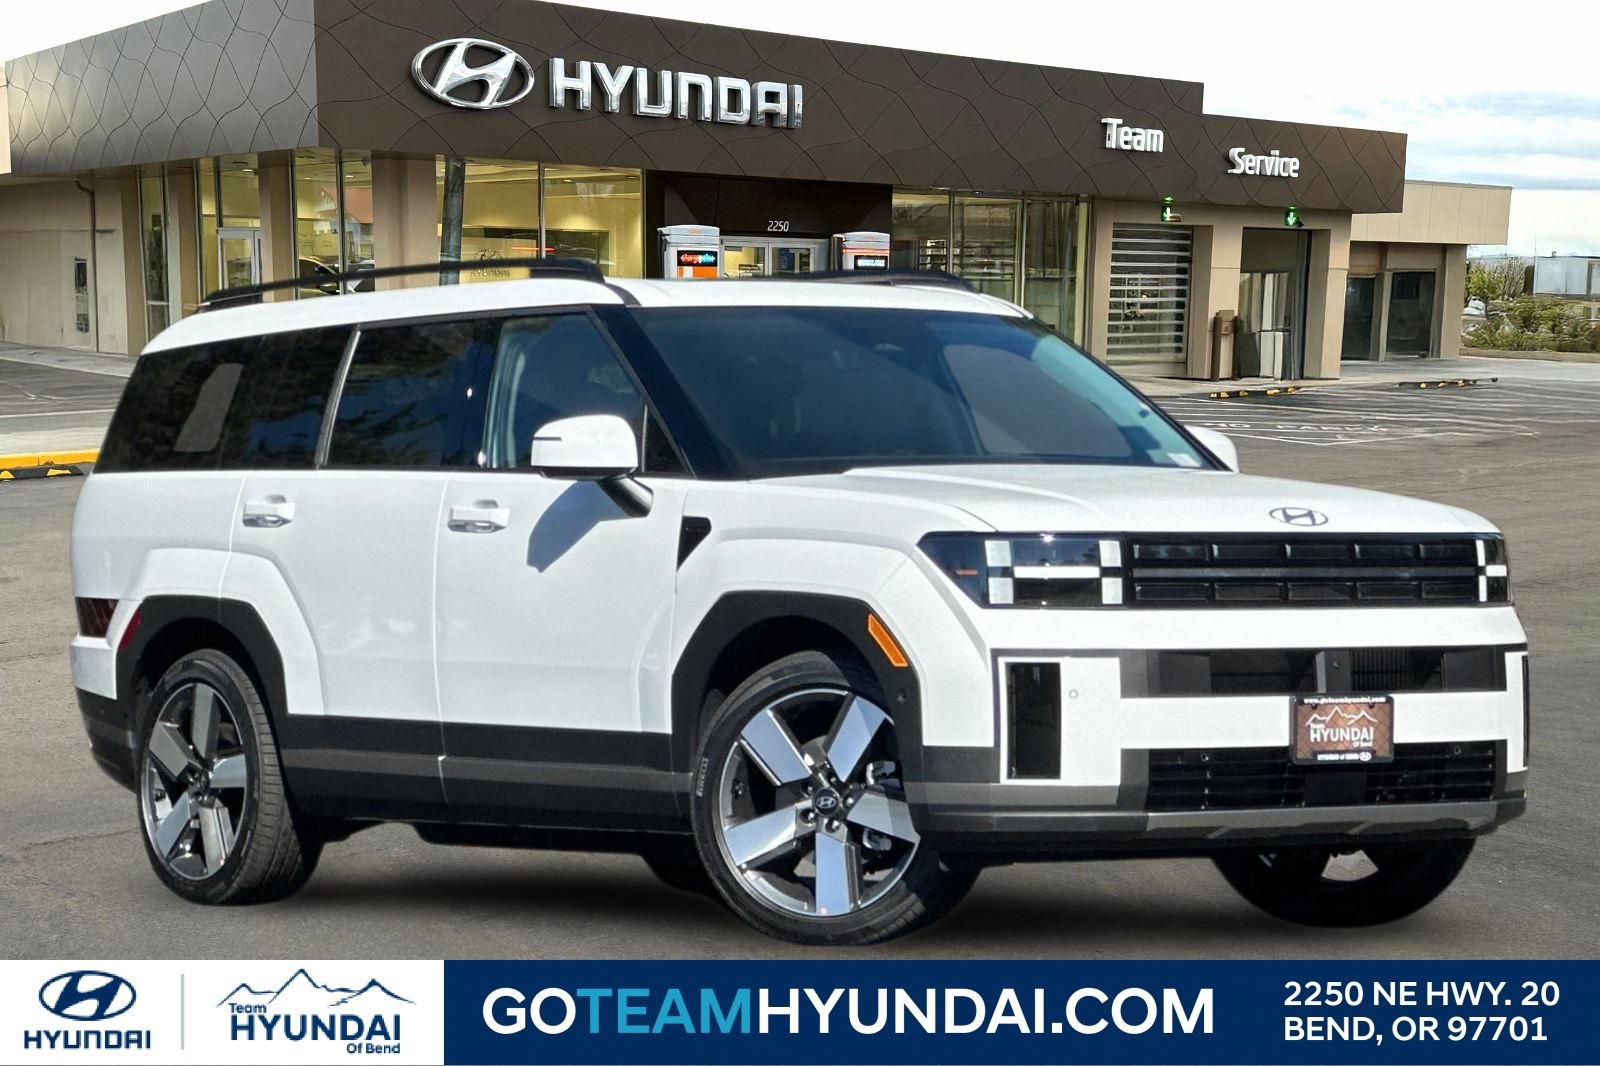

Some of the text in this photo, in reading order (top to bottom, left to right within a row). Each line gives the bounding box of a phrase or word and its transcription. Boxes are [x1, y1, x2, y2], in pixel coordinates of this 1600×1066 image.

[548, 57, 803, 129] HYUNDAI
[1101, 117, 1164, 153] Team
[1227, 147, 1300, 178] Service
[767, 220, 790, 232] 2250
[1310, 726, 1374, 743] HYUNDAI
